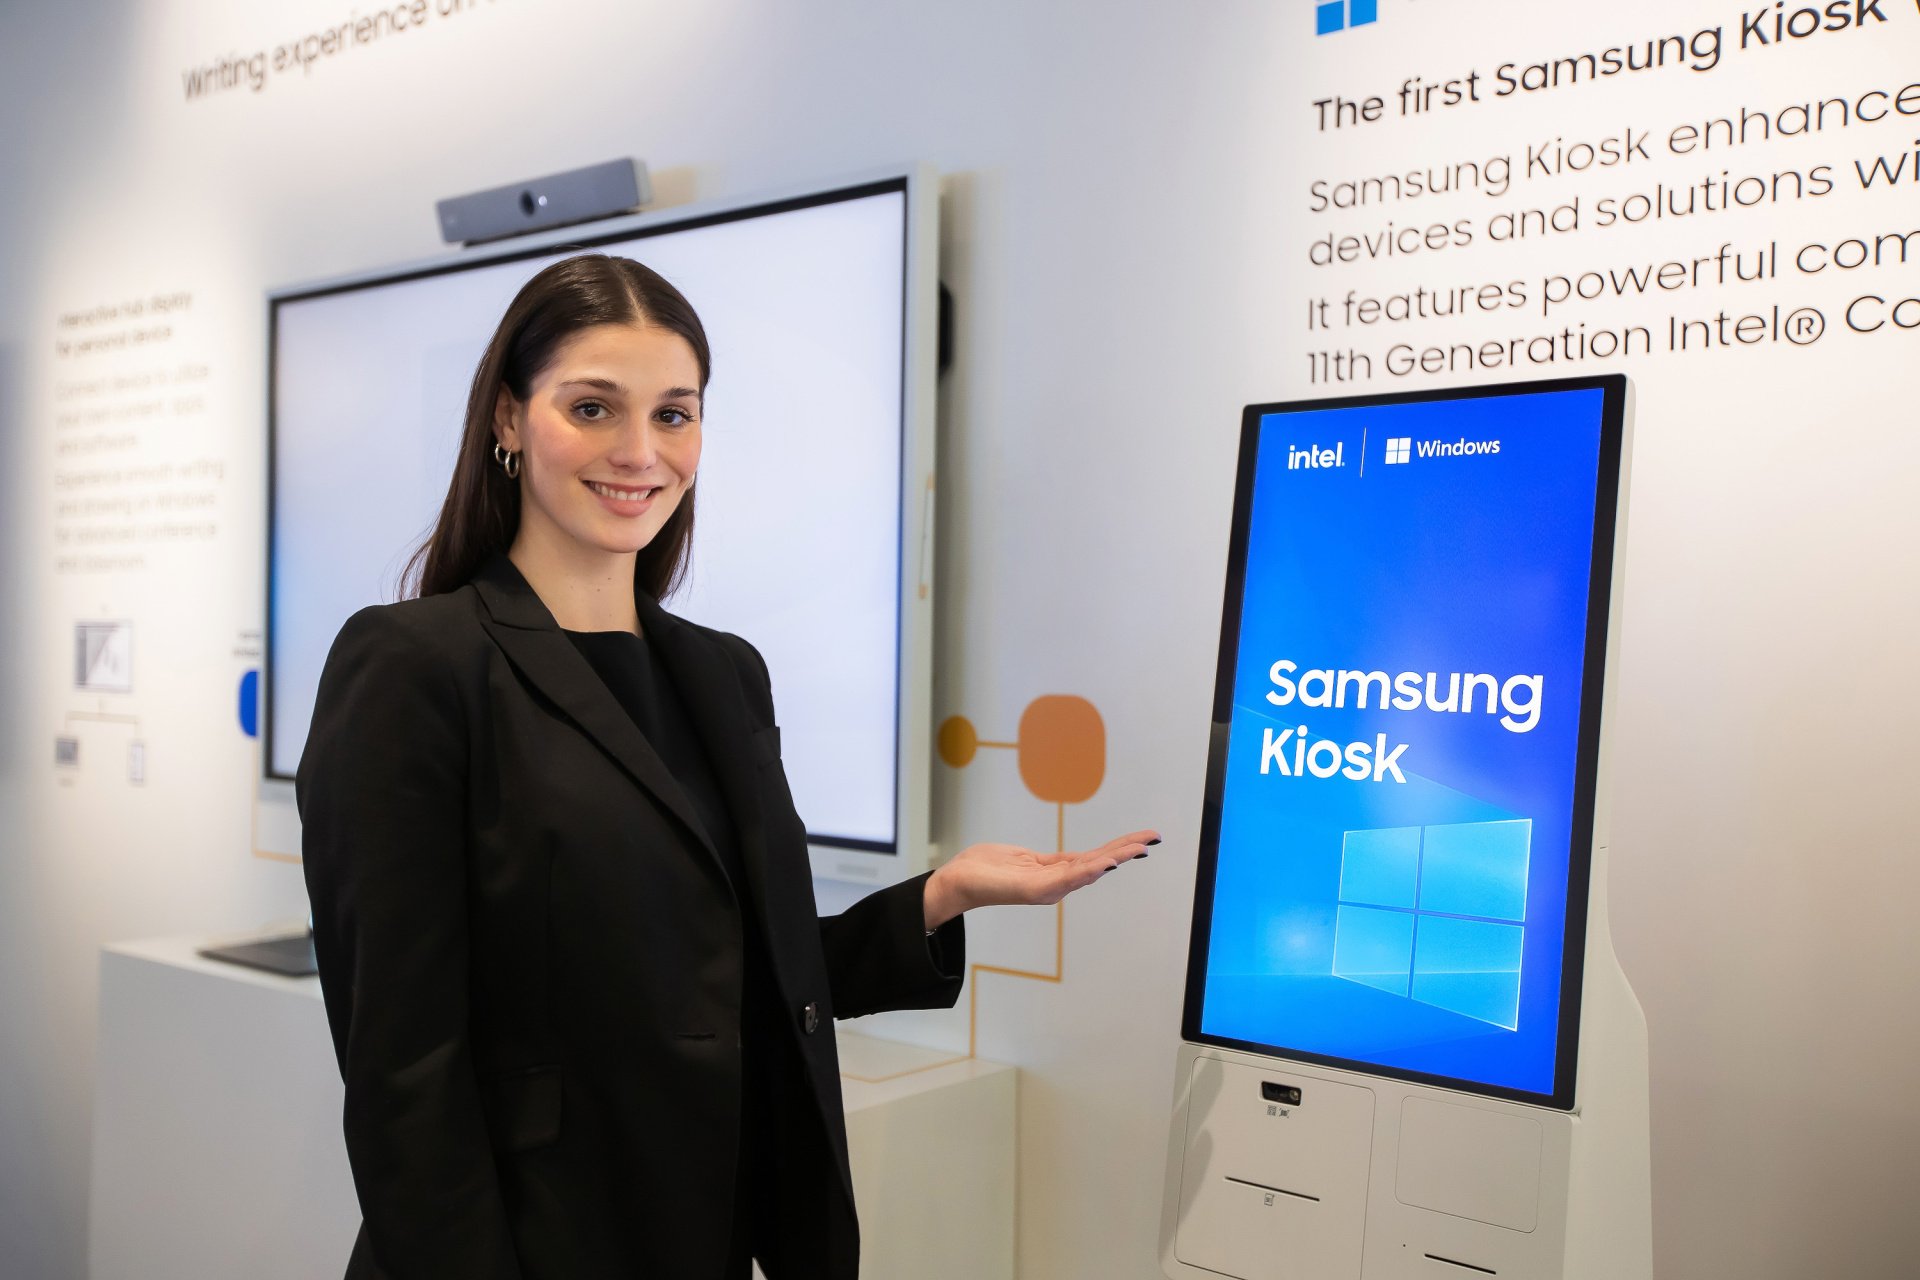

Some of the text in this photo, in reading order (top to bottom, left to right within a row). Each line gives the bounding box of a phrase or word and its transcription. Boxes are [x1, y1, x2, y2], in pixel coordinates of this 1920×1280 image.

[181, 50, 267, 101] Writing
[272, 0, 428, 74] experience
[1312, 0, 1889, 131] The first Samsung Kiosk
[1309, 84, 1920, 213] Samsung Kiosk enhance
[1309, 221, 1473, 267] devices
[1487, 196, 1579, 242] and
[1595, 166, 1834, 228] solutions
[1308, 230, 1920, 331] It features powerful com
[1306, 349, 1372, 384] 11th
[1385, 323, 1651, 377] Generation
[1417, 437, 1501, 458] Windows
[1265, 659, 1544, 733] Samsung
[1260, 725, 1410, 784] Kiosk
